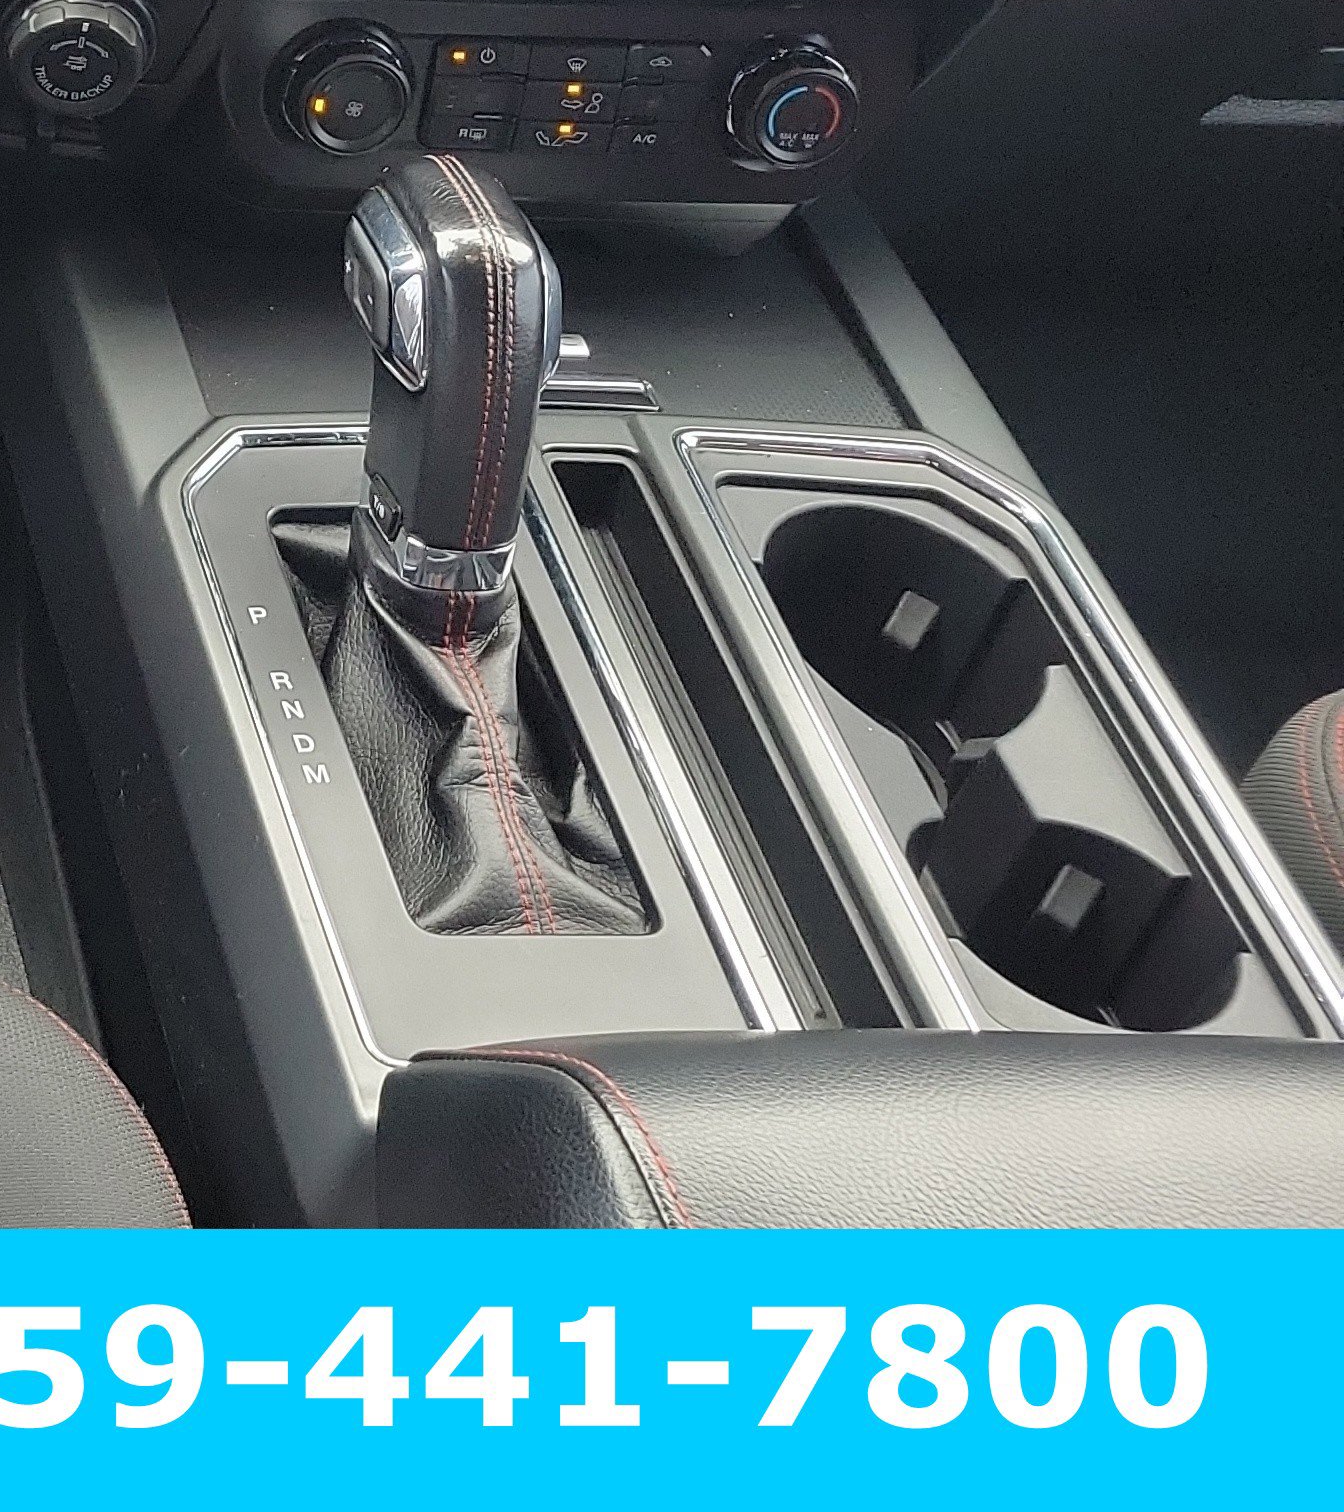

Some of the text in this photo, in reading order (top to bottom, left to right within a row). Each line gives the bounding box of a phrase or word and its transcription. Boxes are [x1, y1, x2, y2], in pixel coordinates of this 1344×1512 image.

[633, 133, 656, 144] A/C
[247, 606, 267, 625] P
[269, 670, 293, 690] R
[281, 700, 305, 719] N
[292, 734, 315, 753] D
[302, 764, 331, 784] M
